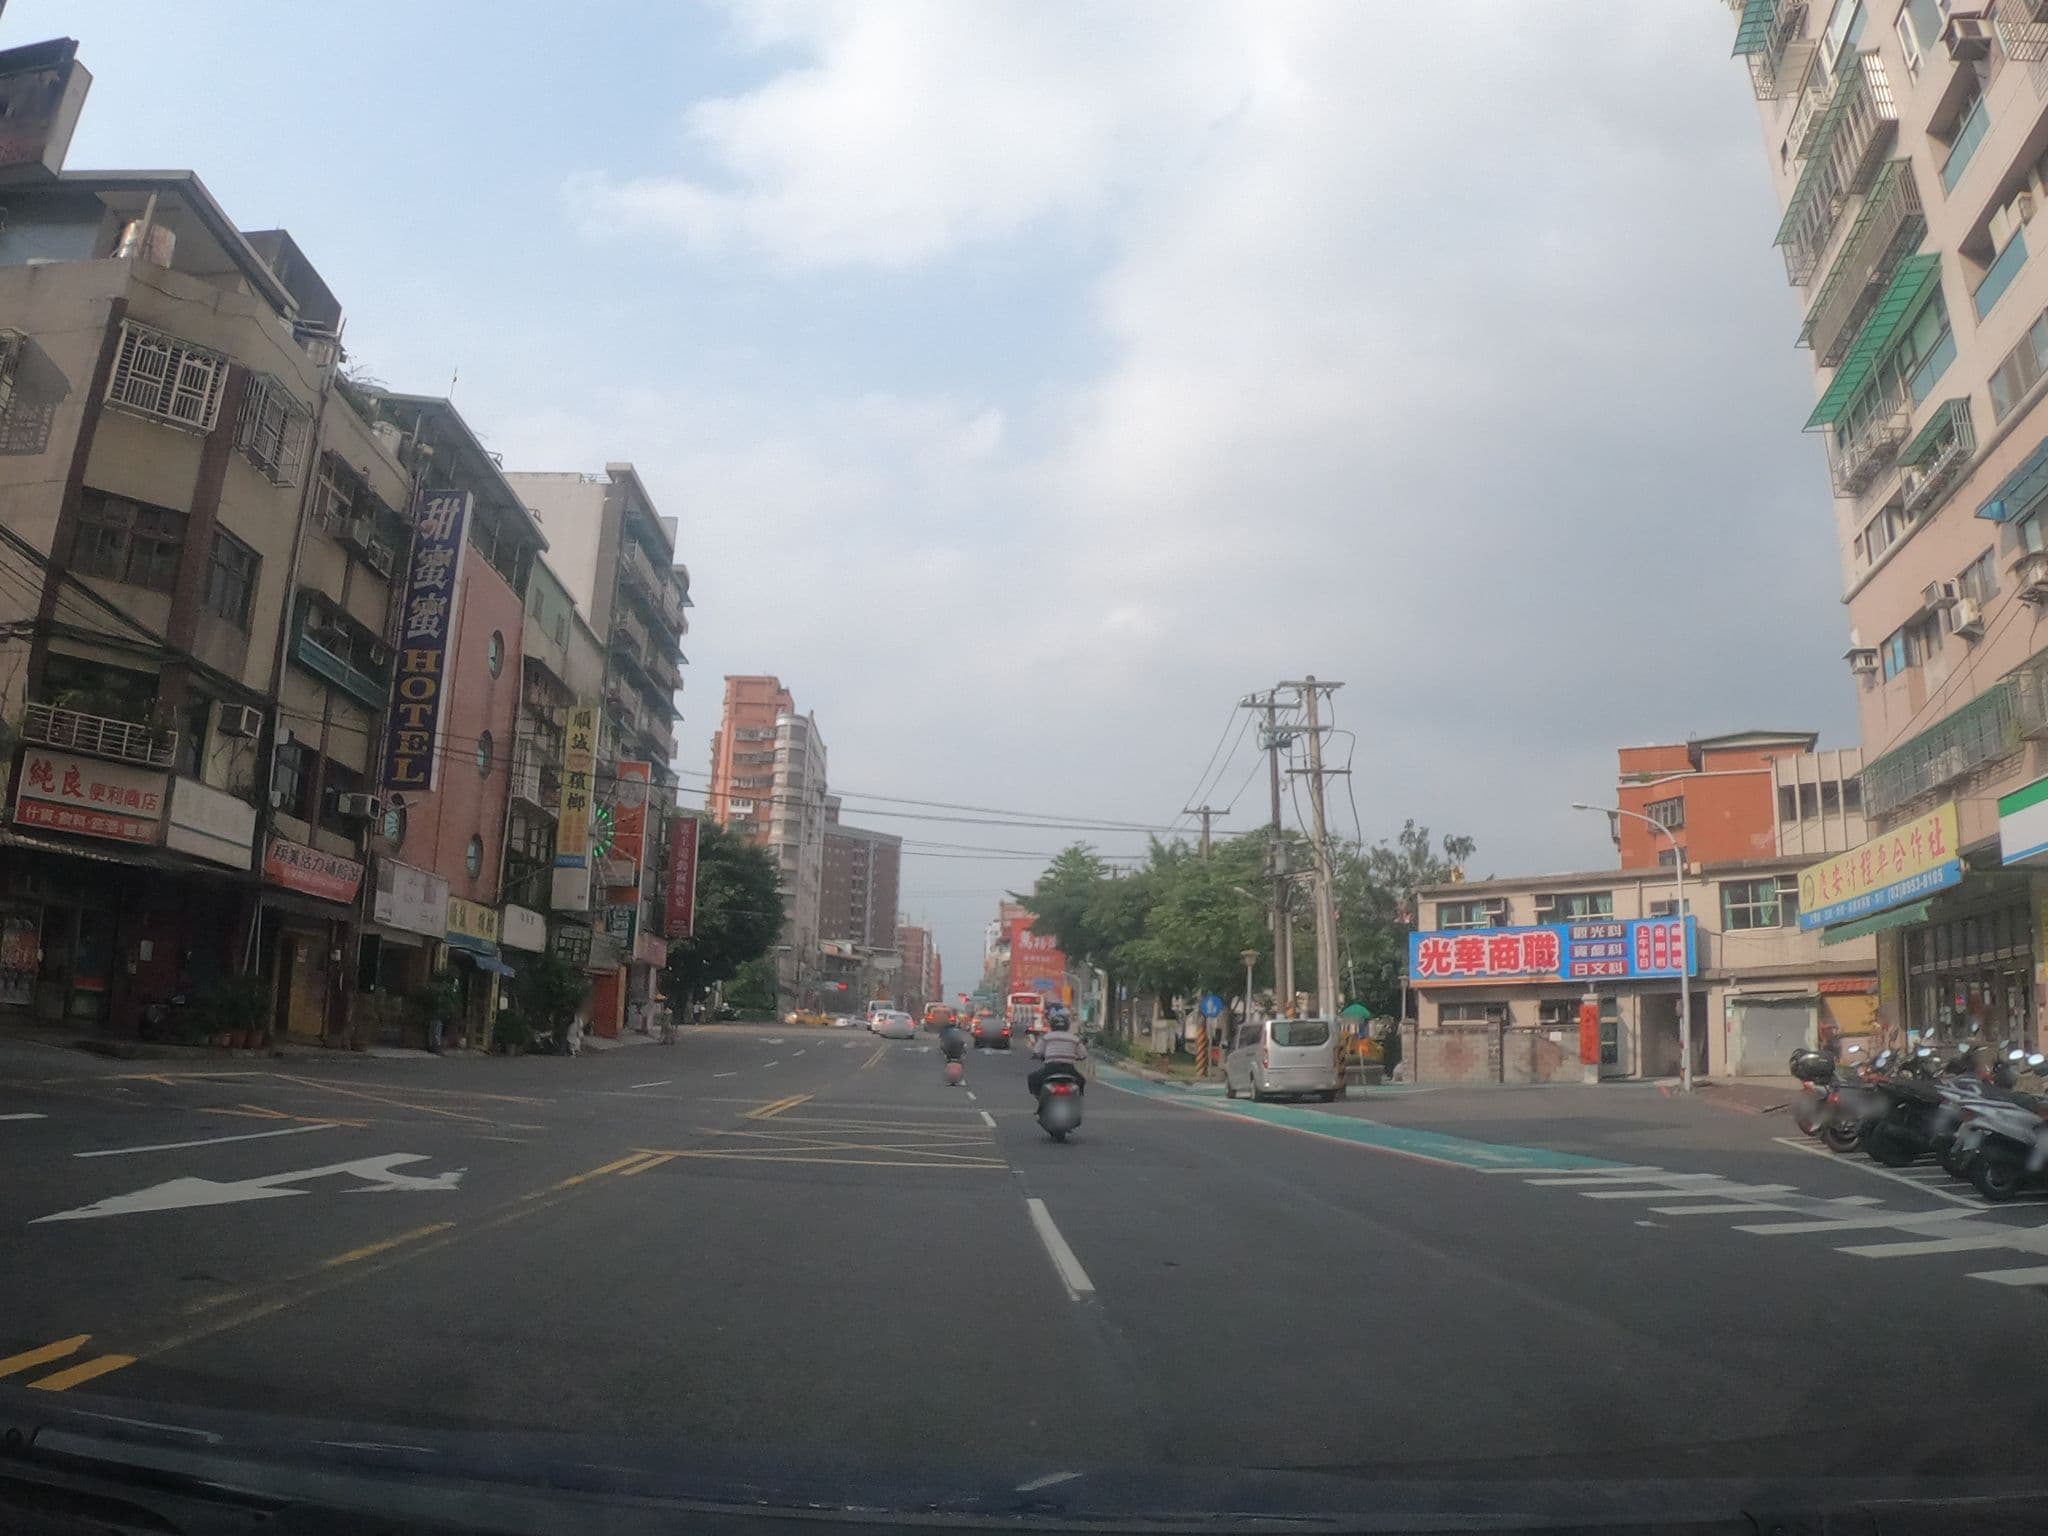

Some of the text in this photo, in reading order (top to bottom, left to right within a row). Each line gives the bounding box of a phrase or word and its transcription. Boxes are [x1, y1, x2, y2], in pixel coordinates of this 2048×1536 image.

[392, 497, 460, 783] 甜蜜蜜 HOTEL
[1419, 930, 1559, 978] 光華商職
[1574, 960, 1624, 976] 日文科
